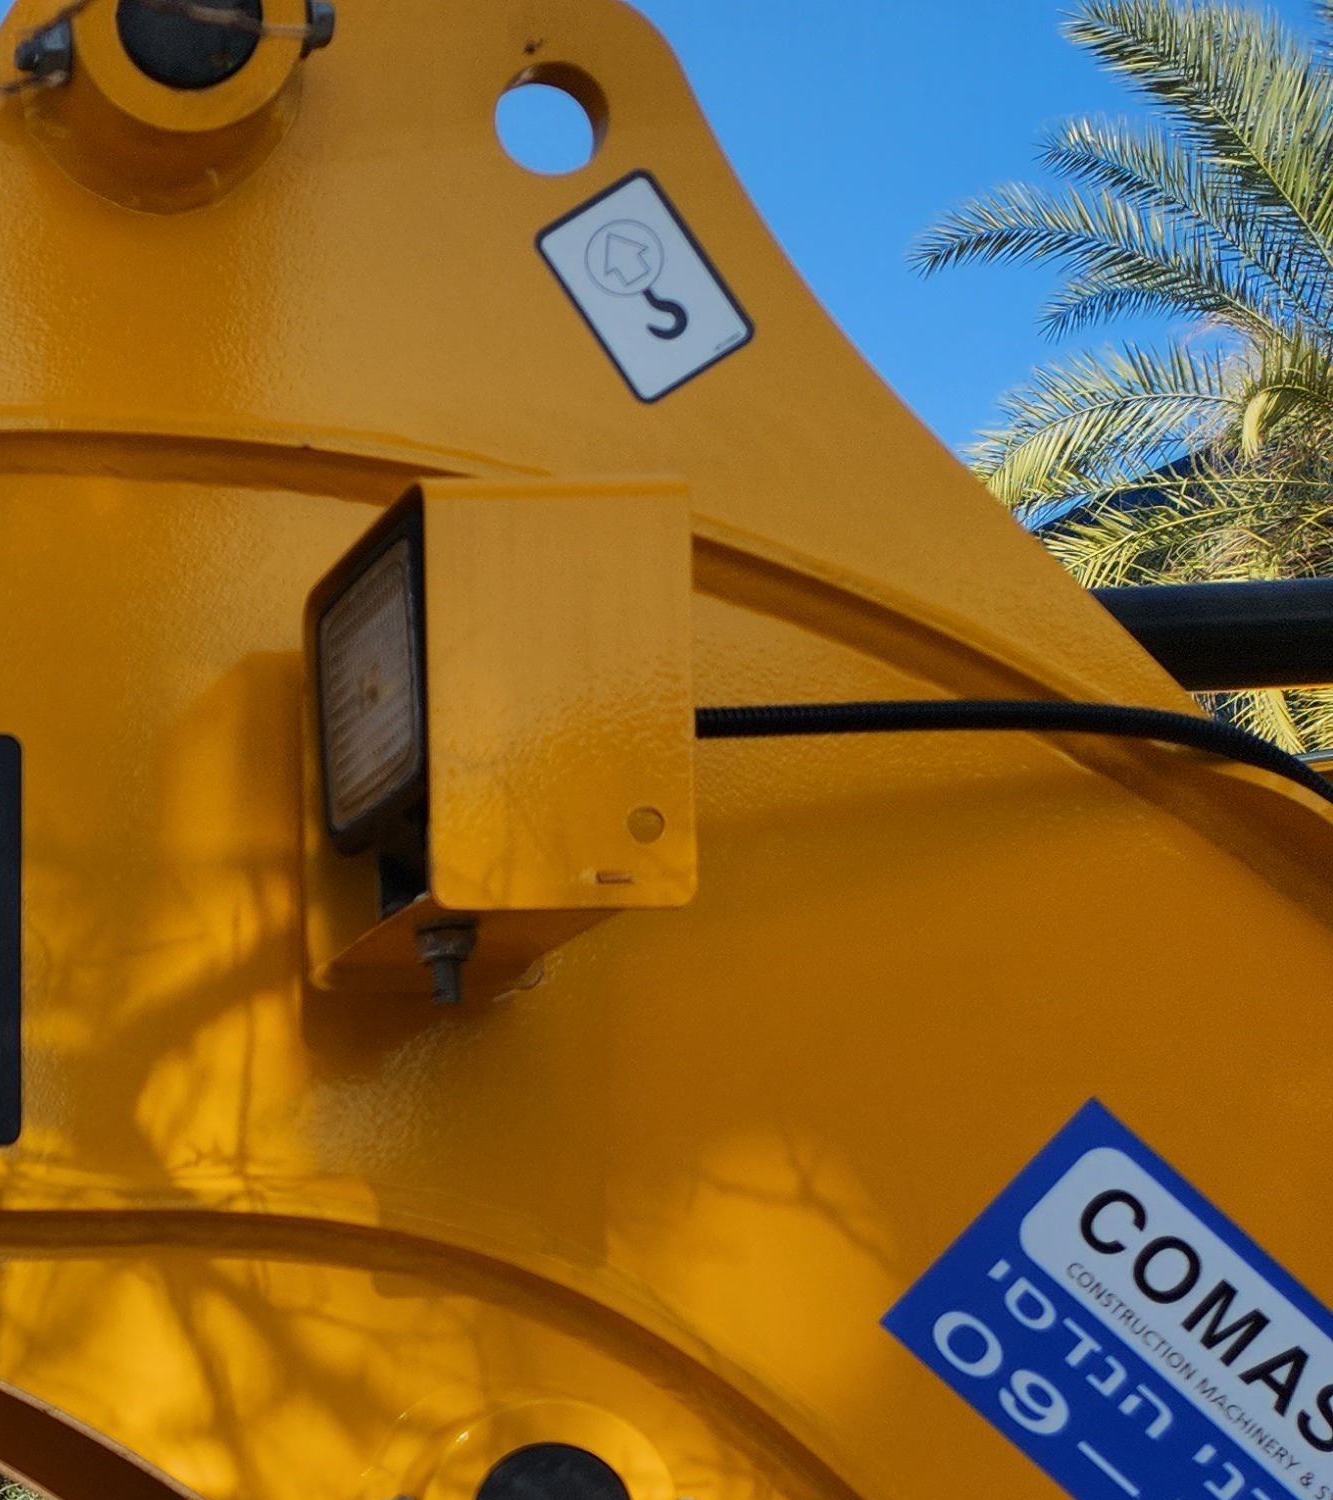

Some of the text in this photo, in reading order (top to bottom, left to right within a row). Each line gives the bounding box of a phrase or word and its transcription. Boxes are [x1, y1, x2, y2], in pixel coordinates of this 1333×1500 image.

[986, 1258, 1174, 1440] הנדסי
[1065, 1261, 1198, 1381] CONSTRUCTION
[1195, 1377, 1301, 1470] MACHINERY
